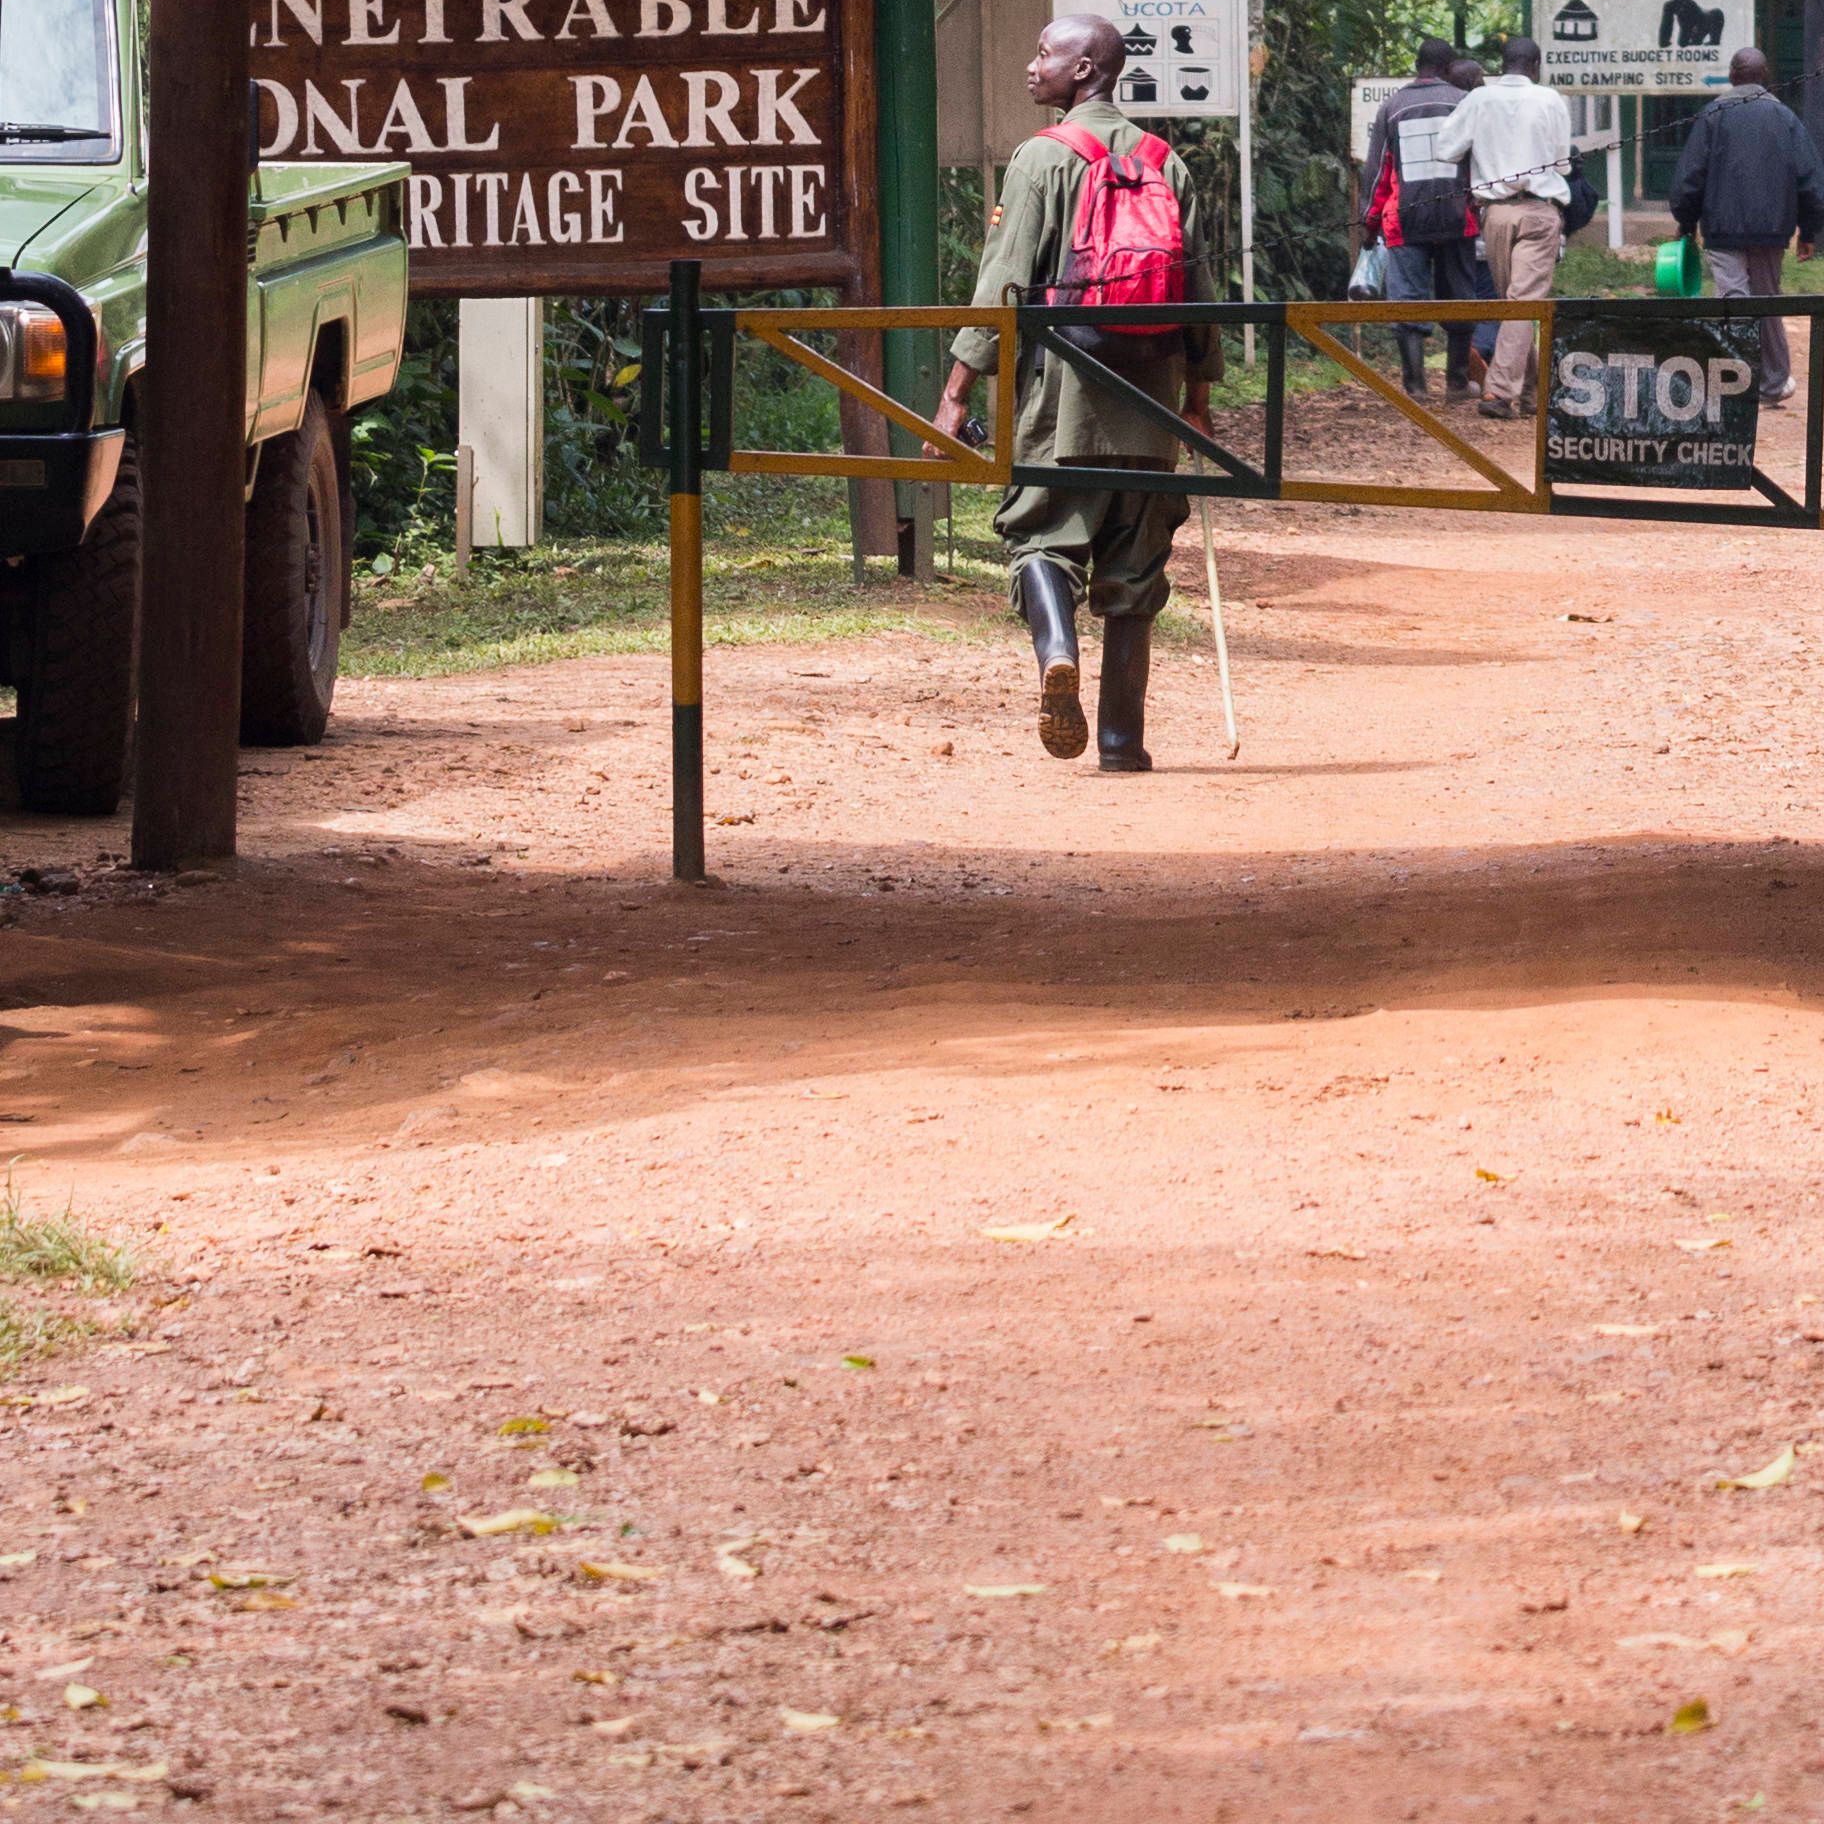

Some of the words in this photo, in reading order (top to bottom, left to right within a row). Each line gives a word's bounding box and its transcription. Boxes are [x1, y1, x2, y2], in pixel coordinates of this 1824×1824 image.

[1546, 51, 1617, 64] EXECUTIVE
[1622, 50, 1672, 63] BUDGET
[1676, 49, 1720, 62] ROOMS
[1549, 72, 1574, 85] AND
[1581, 72, 1645, 86] CAMPING
[1655, 72, 1694, 85] SITES
[567, 68, 822, 150] PARK
[683, 165, 827, 242] SITE
[1558, 351, 1752, 423] STOP
[1548, 436, 1669, 463] SECURITY
[1677, 441, 1753, 466] CHECK
